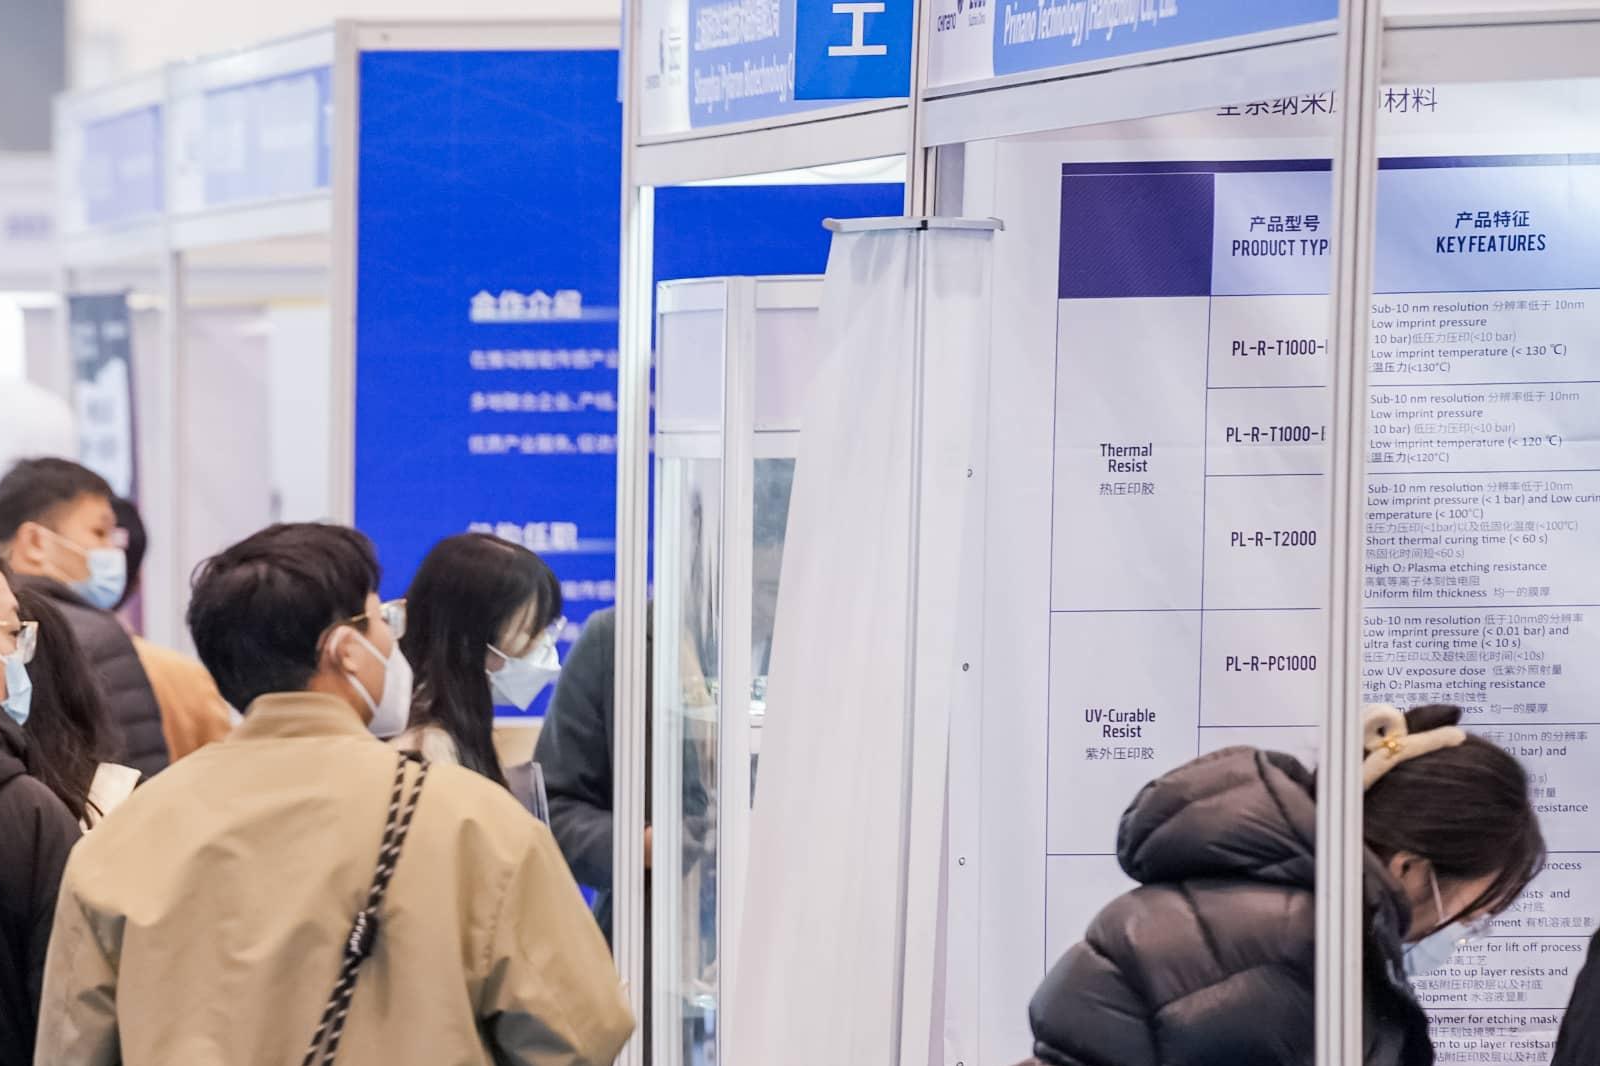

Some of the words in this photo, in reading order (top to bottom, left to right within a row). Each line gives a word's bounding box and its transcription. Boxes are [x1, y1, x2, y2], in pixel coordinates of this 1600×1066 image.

[1250, 215, 1320, 232] 产品型号
[1455, 211, 1529, 228] 产品特征
[1232, 240, 1295, 256] PRODUCT
[1300, 239, 1328, 256] TYP
[1436, 236, 1469, 253] KEY
[1469, 234, 1545, 252] FEATURES
[1372, 304, 1409, 313] Sub-10
[1433, 303, 1488, 312] resolution
[1555, 300, 1584, 310] 10nm
[1372, 320, 1393, 328] Low
[1397, 319, 1436, 329] imprint
[1440, 319, 1487, 327] pressure
[1232, 340, 1327, 356] PL-R-T1000-
[1371, 350, 1392, 358] Low
[1396, 349, 1434, 360] imprint
[1438, 348, 1508, 358] temperature
[1526, 346, 1546, 355] 130
[1370, 394, 1407, 404] Sub-10
[1431, 393, 1484, 403] resolution
[1550, 392, 1579, 400] 10nm
[1371, 410, 1392, 419] Low
[1395, 409, 1434, 420] imprint
[1437, 410, 1483, 419] pressure
[1370, 440, 1392, 448] Low
[1394, 439, 1434, 450] imprint
[1437, 438, 1505, 448] temperature
[1523, 437, 1542, 446] 120
[1100, 443, 1152, 458] Thermal
[1109, 459, 1147, 472] Resist
[1100, 482, 1155, 495] 热压印胶
[1368, 484, 1406, 494] Sub-10
[1430, 483, 1483, 492] resolution
[1368, 497, 1389, 506] Low
[1392, 496, 1430, 507] imprint
[1434, 497, 1478, 508] pressure
[1504, 494, 1525, 505] bar)
[1528, 494, 1548, 503] and
[1551, 494, 1572, 503] Low
[1367, 511, 1432, 521] emperature
[1232, 531, 1316, 547] PL-R-T2000
[1366, 536, 1395, 545] Short
[1398, 535, 1441, 545] thermal
[1445, 535, 1478, 547] curing
[1481, 535, 1505, 544] time
[1523, 534, 1536, 543] 60
[1365, 563, 1389, 575] High
[1408, 563, 1446, 572] Plasma
[1449, 562, 1489, 575] etching
[1493, 563, 1547, 571] resistance
[1365, 588, 1408, 598] Uniform
[1412, 588, 1432, 598] film
[1436, 587, 1487, 598] thickness
[1364, 616, 1401, 625] Sub-10
[1425, 616, 1480, 624] resolution
[1363, 629, 1385, 637] Low
[1388, 626, 1428, 638] imprint
[1432, 626, 1479, 638] pressure
[1496, 625, 1519, 636] 0.01
[1524, 626, 1545, 637] bar)
[1549, 625, 1568, 635] and
[1364, 639, 1388, 648] ultra
[1392, 638, 1412, 648] fast
[1416, 638, 1449, 651] curing
[1453, 639, 1477, 648] time
[1496, 638, 1508, 647] 10
[1226, 656, 1316, 671] PL-R-PC1000
[1363, 668, 1383, 676] Low
[1388, 667, 1403, 676] UV
[1406, 667, 1456, 676] exposure
[1459, 666, 1486, 675] dose
[1405, 680, 1442, 689] Plasma
[1446, 679, 1486, 691] etching
[1490, 680, 1545, 688] resistance
[1086, 708, 1155, 724] UV-Curable
[1103, 724, 1141, 737] Resist
[1086, 747, 1154, 760] 紫外压印胶
[1521, 746, 1542, 757] bar)
[1546, 746, 1566, 756] and
[1550, 889, 1570, 898] and
[1487, 942, 1502, 952] for
[1506, 942, 1520, 952] lift
[1523, 942, 1538, 952] off
[1541, 944, 1582, 953] process
[1450, 968, 1461, 976] to
[1464, 969, 1477, 979] up
[1481, 966, 1507, 979] layer
[1511, 967, 1545, 976] resists
[1548, 967, 1568, 976] and
[1468, 1015, 1483, 1024] for
[1487, 1014, 1526, 1026] etching
[1530, 1015, 1559, 1025] mask
[1449, 1040, 1460, 1048] to
[1464, 1042, 1477, 1051] up
[1481, 1039, 1506, 1051] layer
